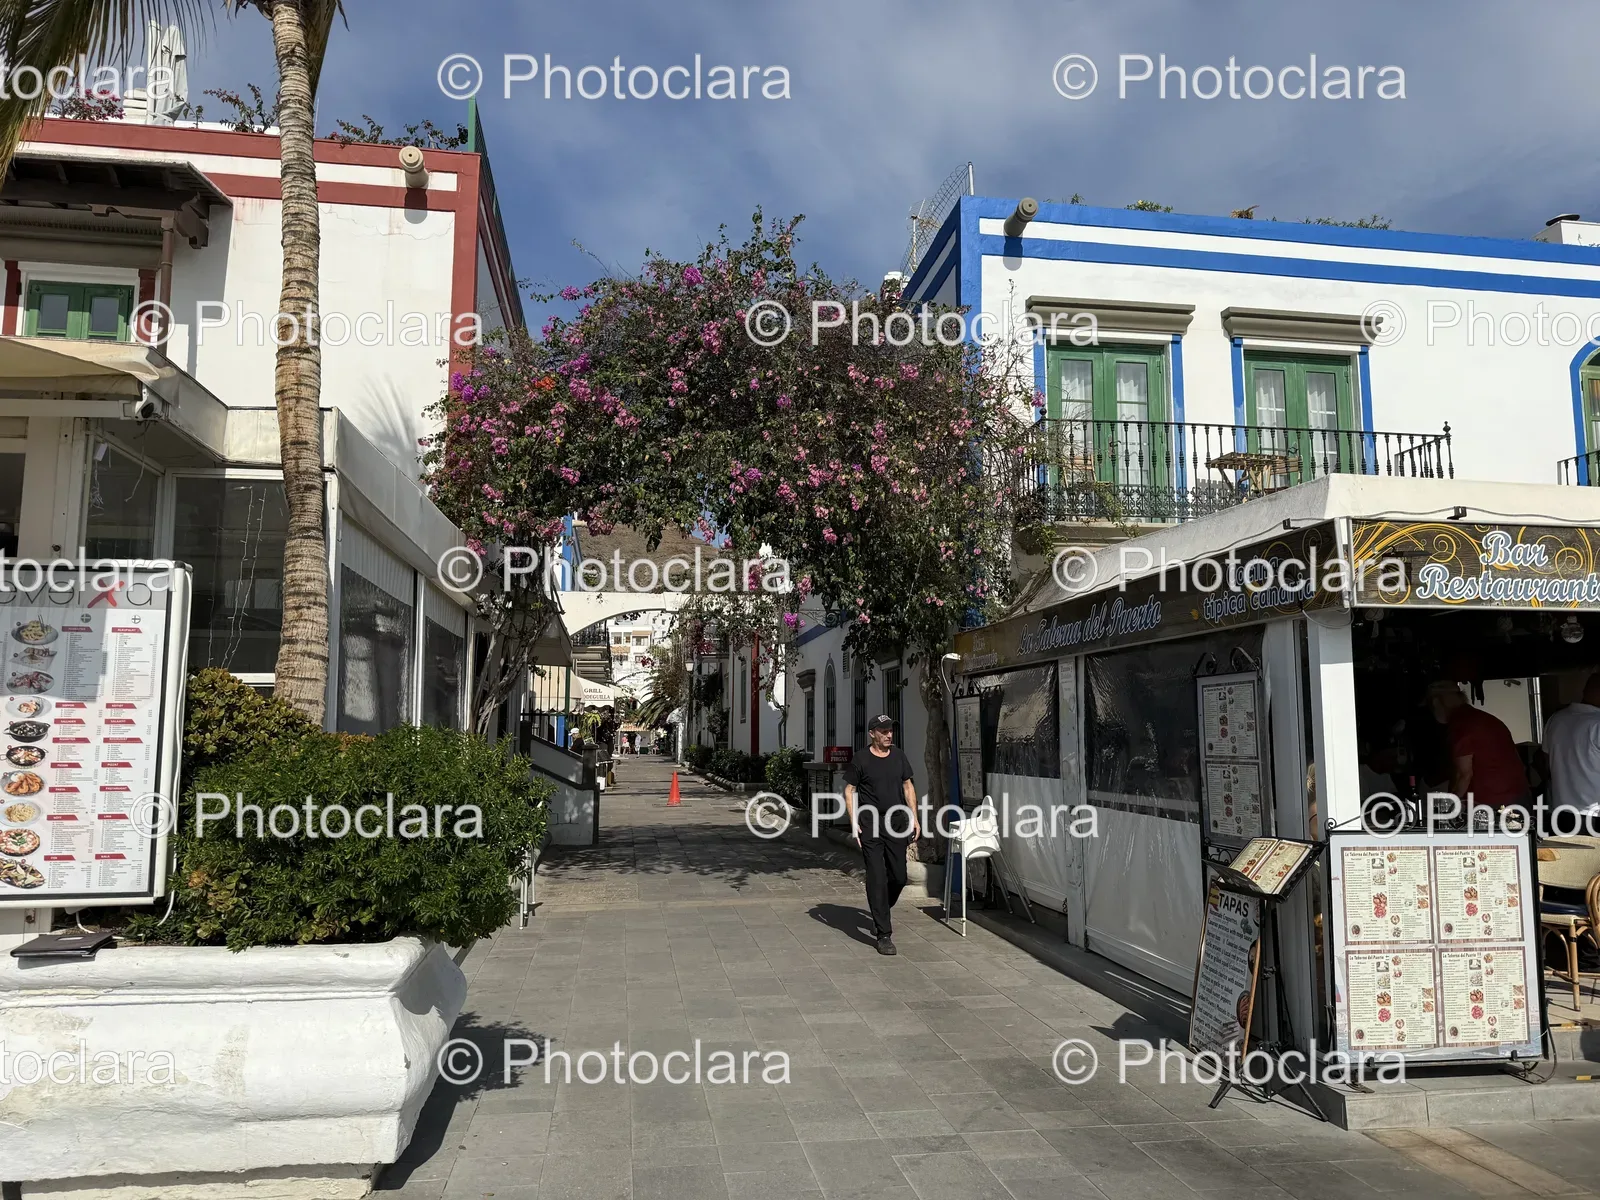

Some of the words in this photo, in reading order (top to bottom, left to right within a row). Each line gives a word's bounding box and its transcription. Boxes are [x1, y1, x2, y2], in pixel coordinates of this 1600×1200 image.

[1479, 530, 1548, 566] Bar
[1083, 603, 1106, 642] del
[1106, 594, 1162, 637] Puerto
[1204, 591, 1246, 623] típica
[1219, 893, 1249, 918] TAPAS
